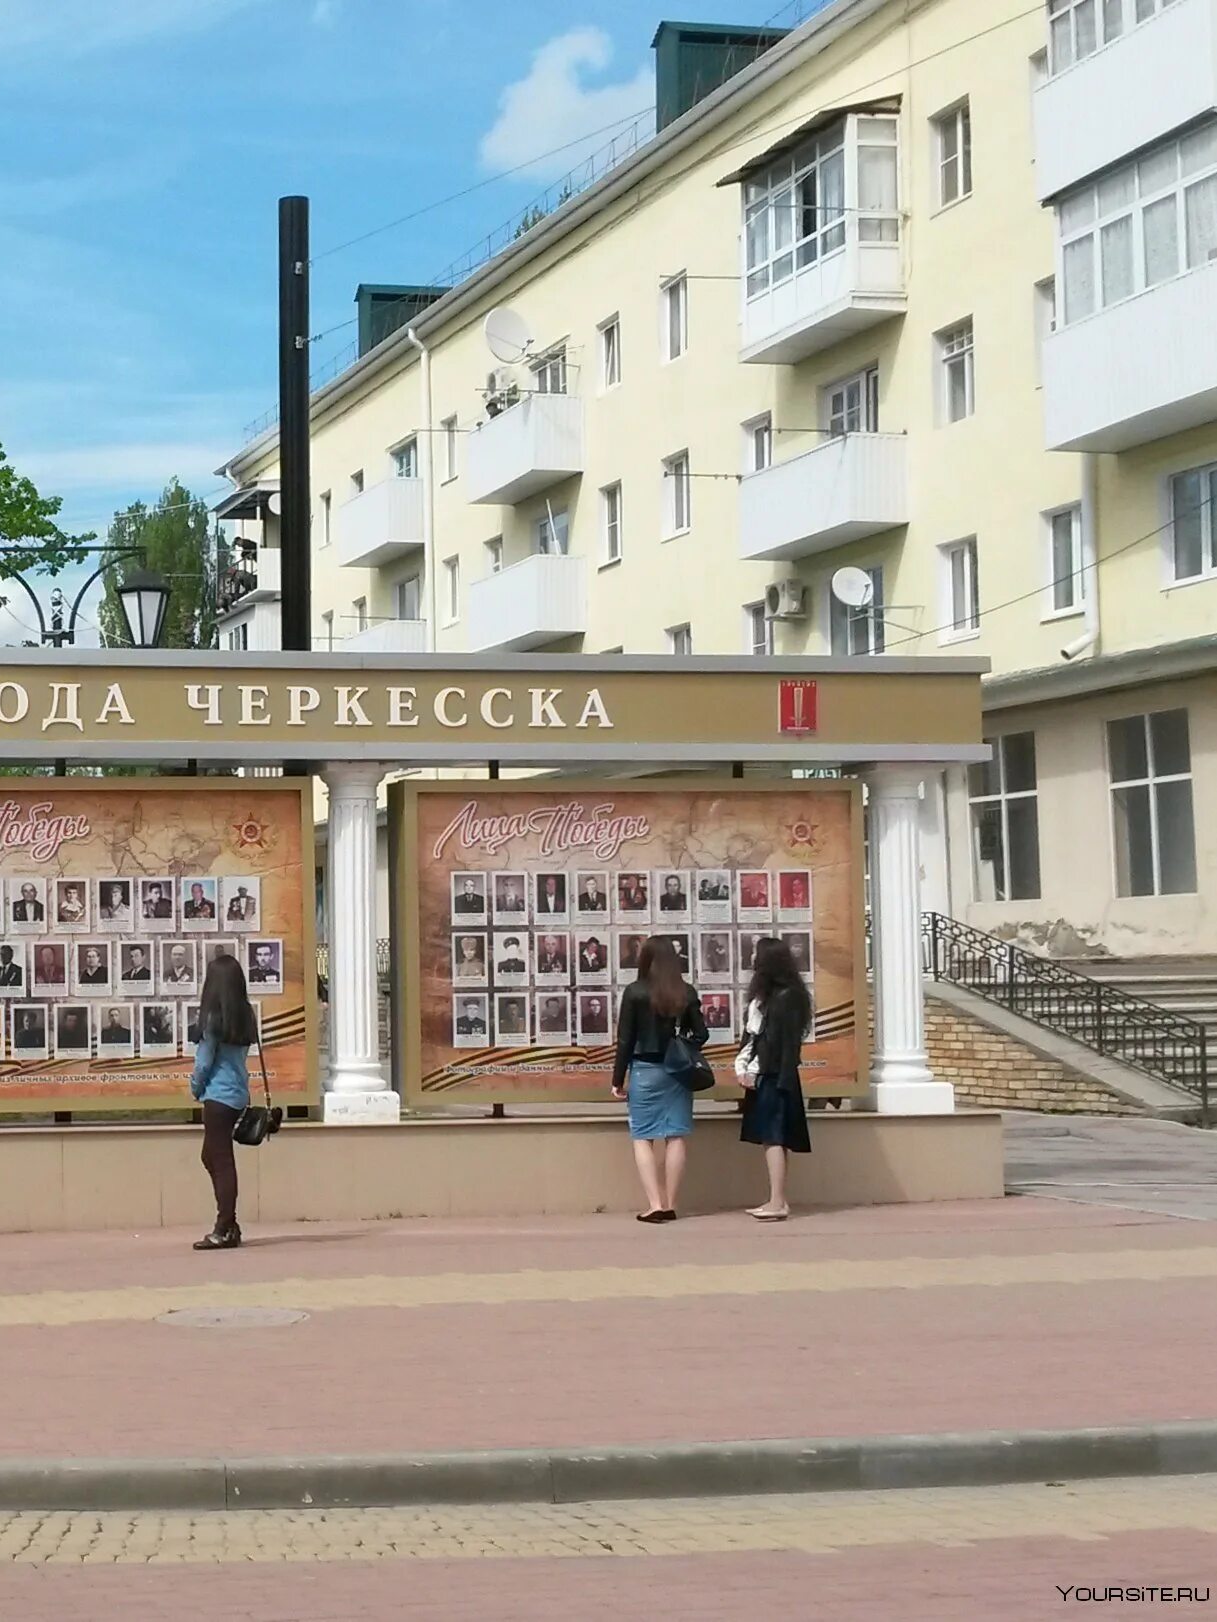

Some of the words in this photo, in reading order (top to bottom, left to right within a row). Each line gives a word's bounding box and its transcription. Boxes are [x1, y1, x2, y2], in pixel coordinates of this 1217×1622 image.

[184, 684, 614, 728] ЧЕРКЕССКА
[434, 800, 527, 858] Лица
[528, 801, 650, 861] Победы
